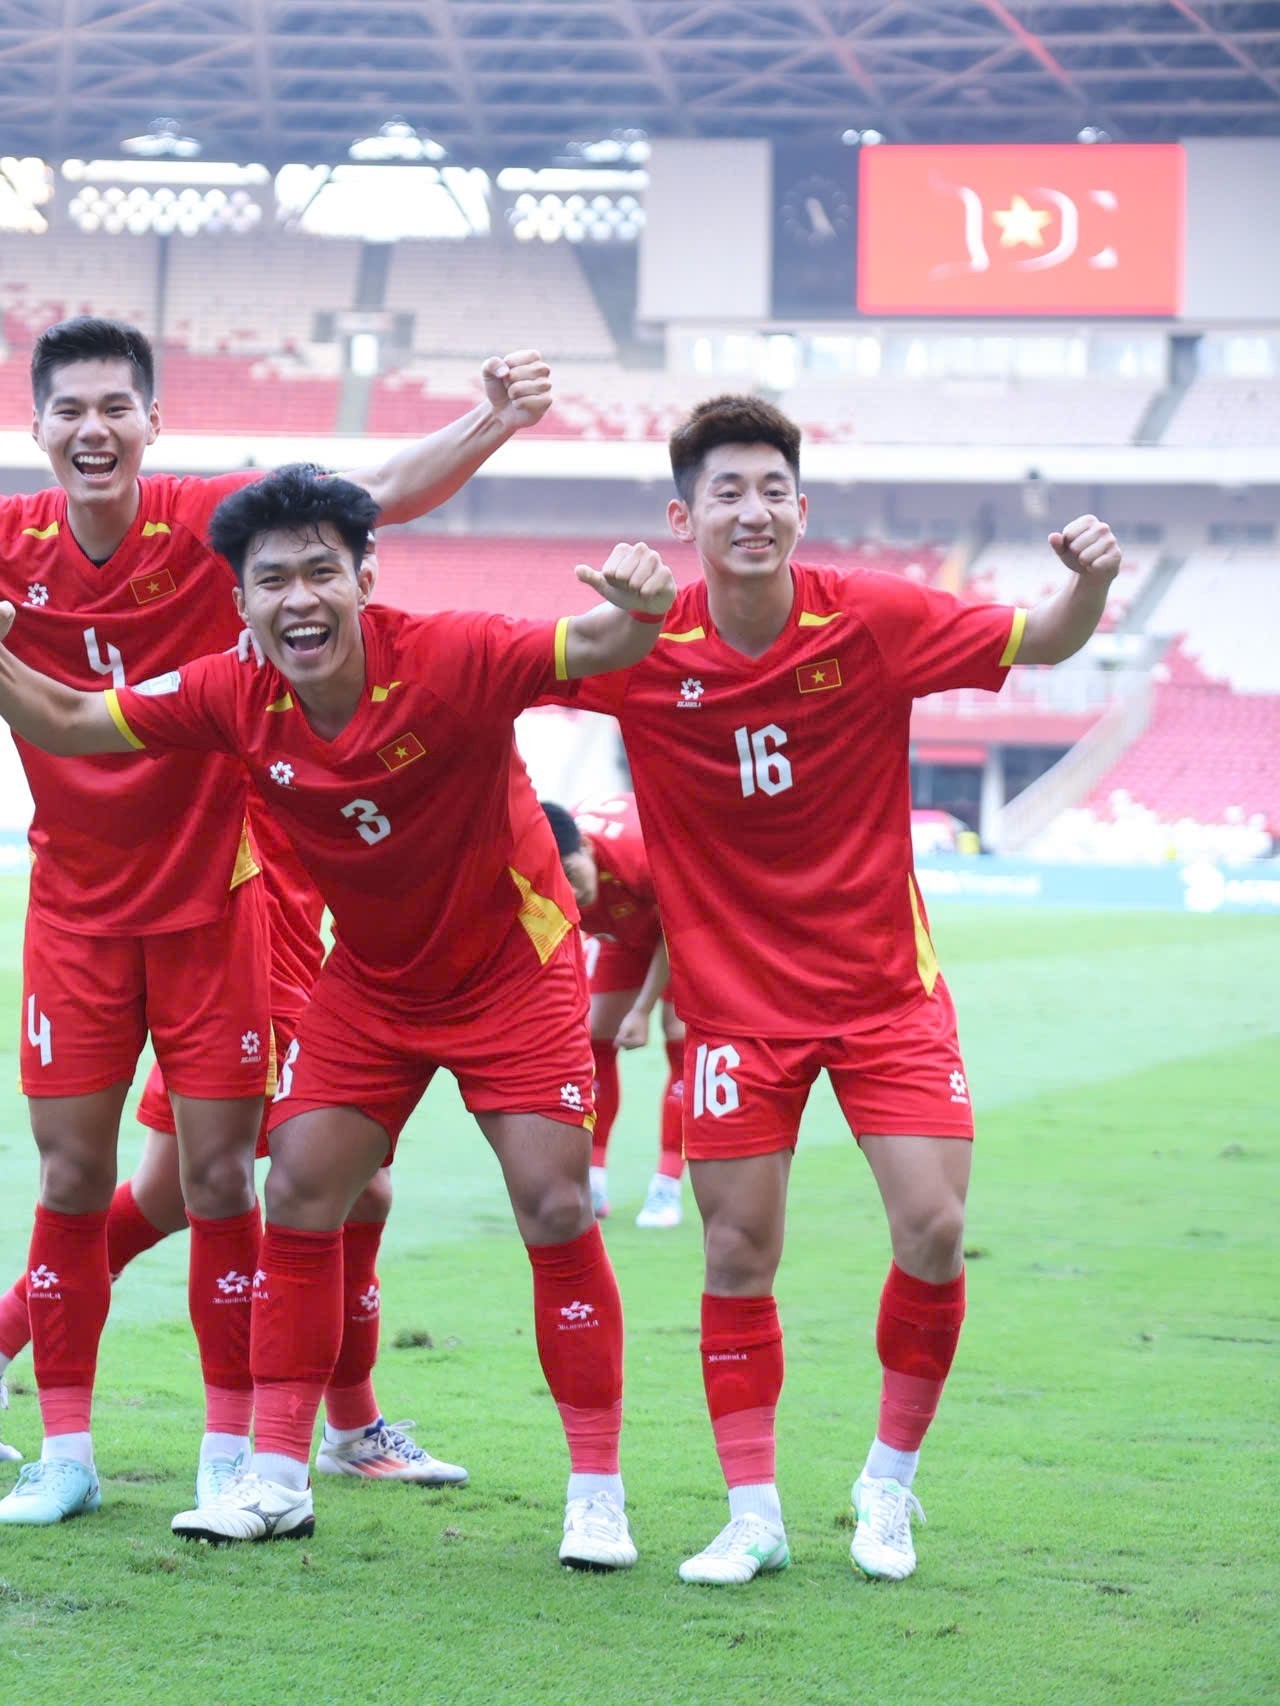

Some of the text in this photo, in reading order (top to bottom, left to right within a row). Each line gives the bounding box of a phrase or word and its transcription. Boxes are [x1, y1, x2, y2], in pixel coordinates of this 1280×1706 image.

[83, 626, 125, 689] 4
[734, 723, 793, 798] 16
[340, 798, 391, 846] 3
[27, 993, 52, 1067] 4
[693, 1043, 741, 1120] 16
